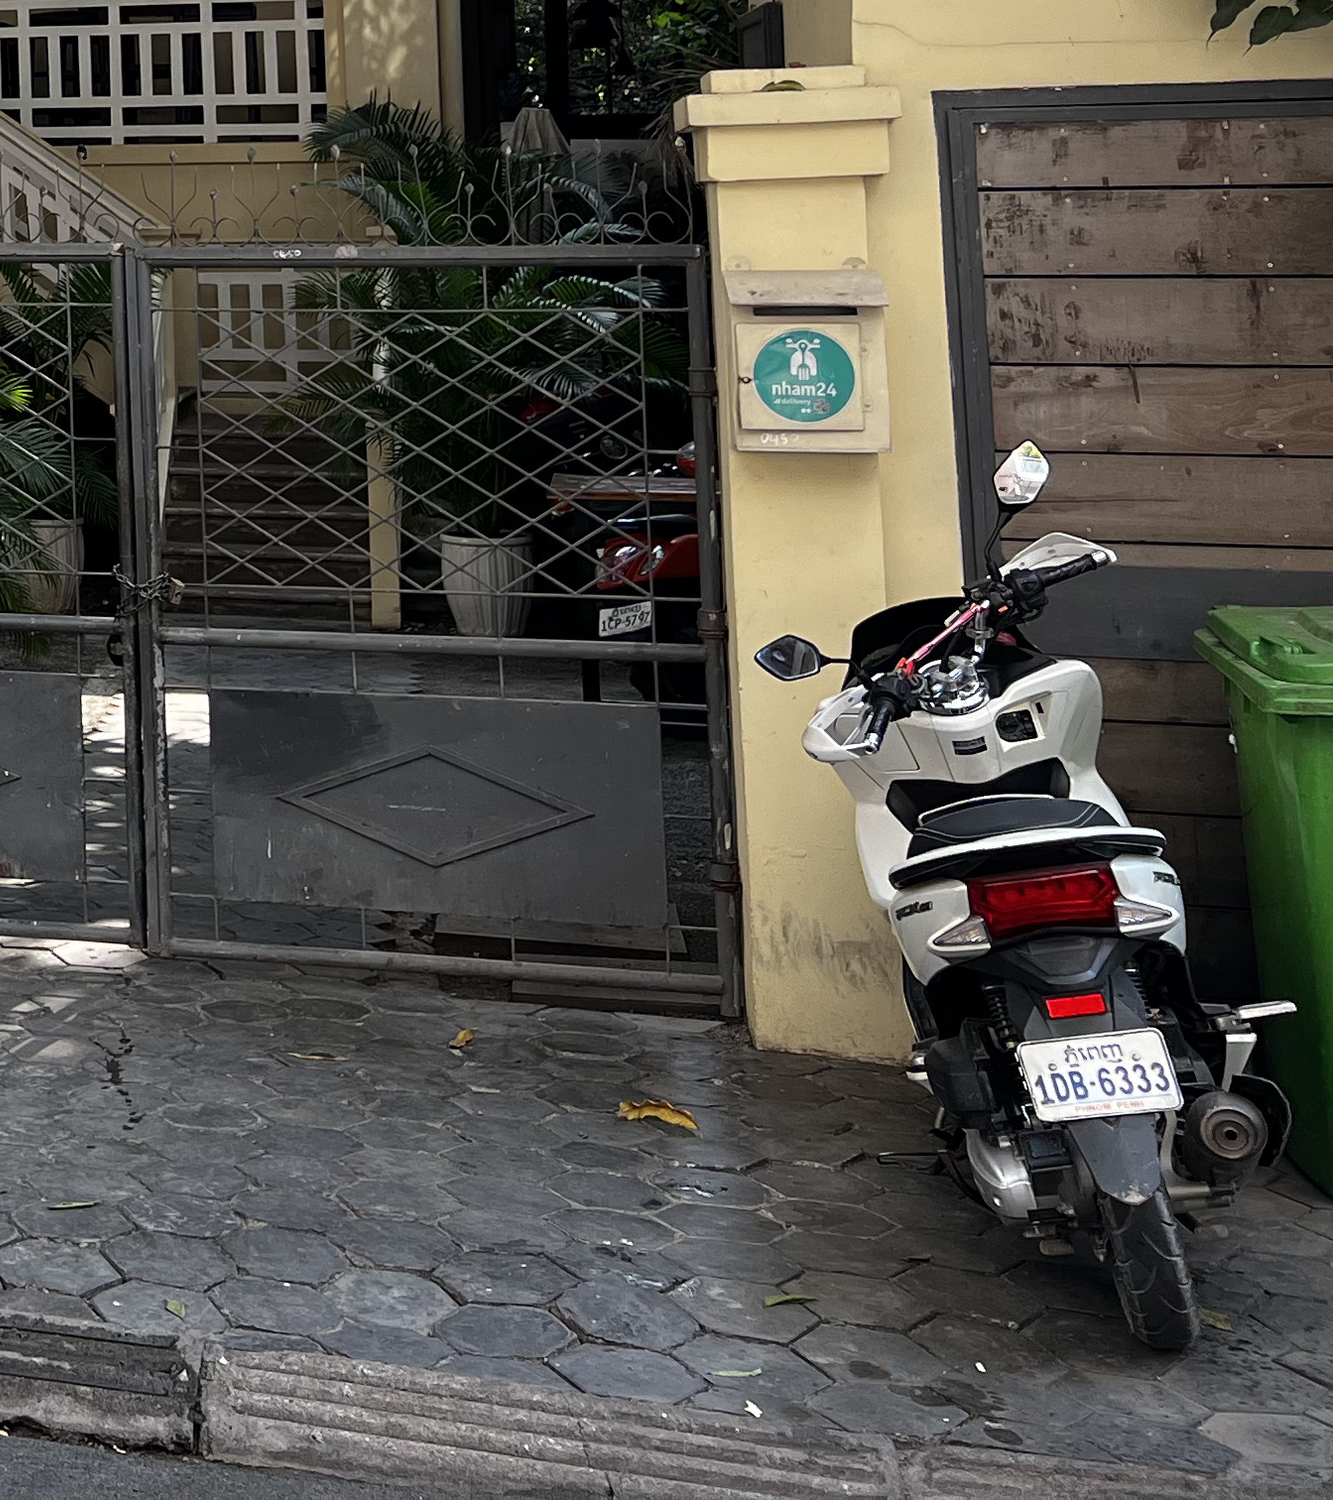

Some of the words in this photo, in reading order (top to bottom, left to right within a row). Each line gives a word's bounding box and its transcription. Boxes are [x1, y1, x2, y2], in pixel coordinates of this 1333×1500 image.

[771, 380, 837, 398] nham24
[1035, 1062, 1170, 1105] 1DB-6333
[1074, 1103, 1112, 1114] PHNOM
[1116, 1100, 1145, 1111] PENH
